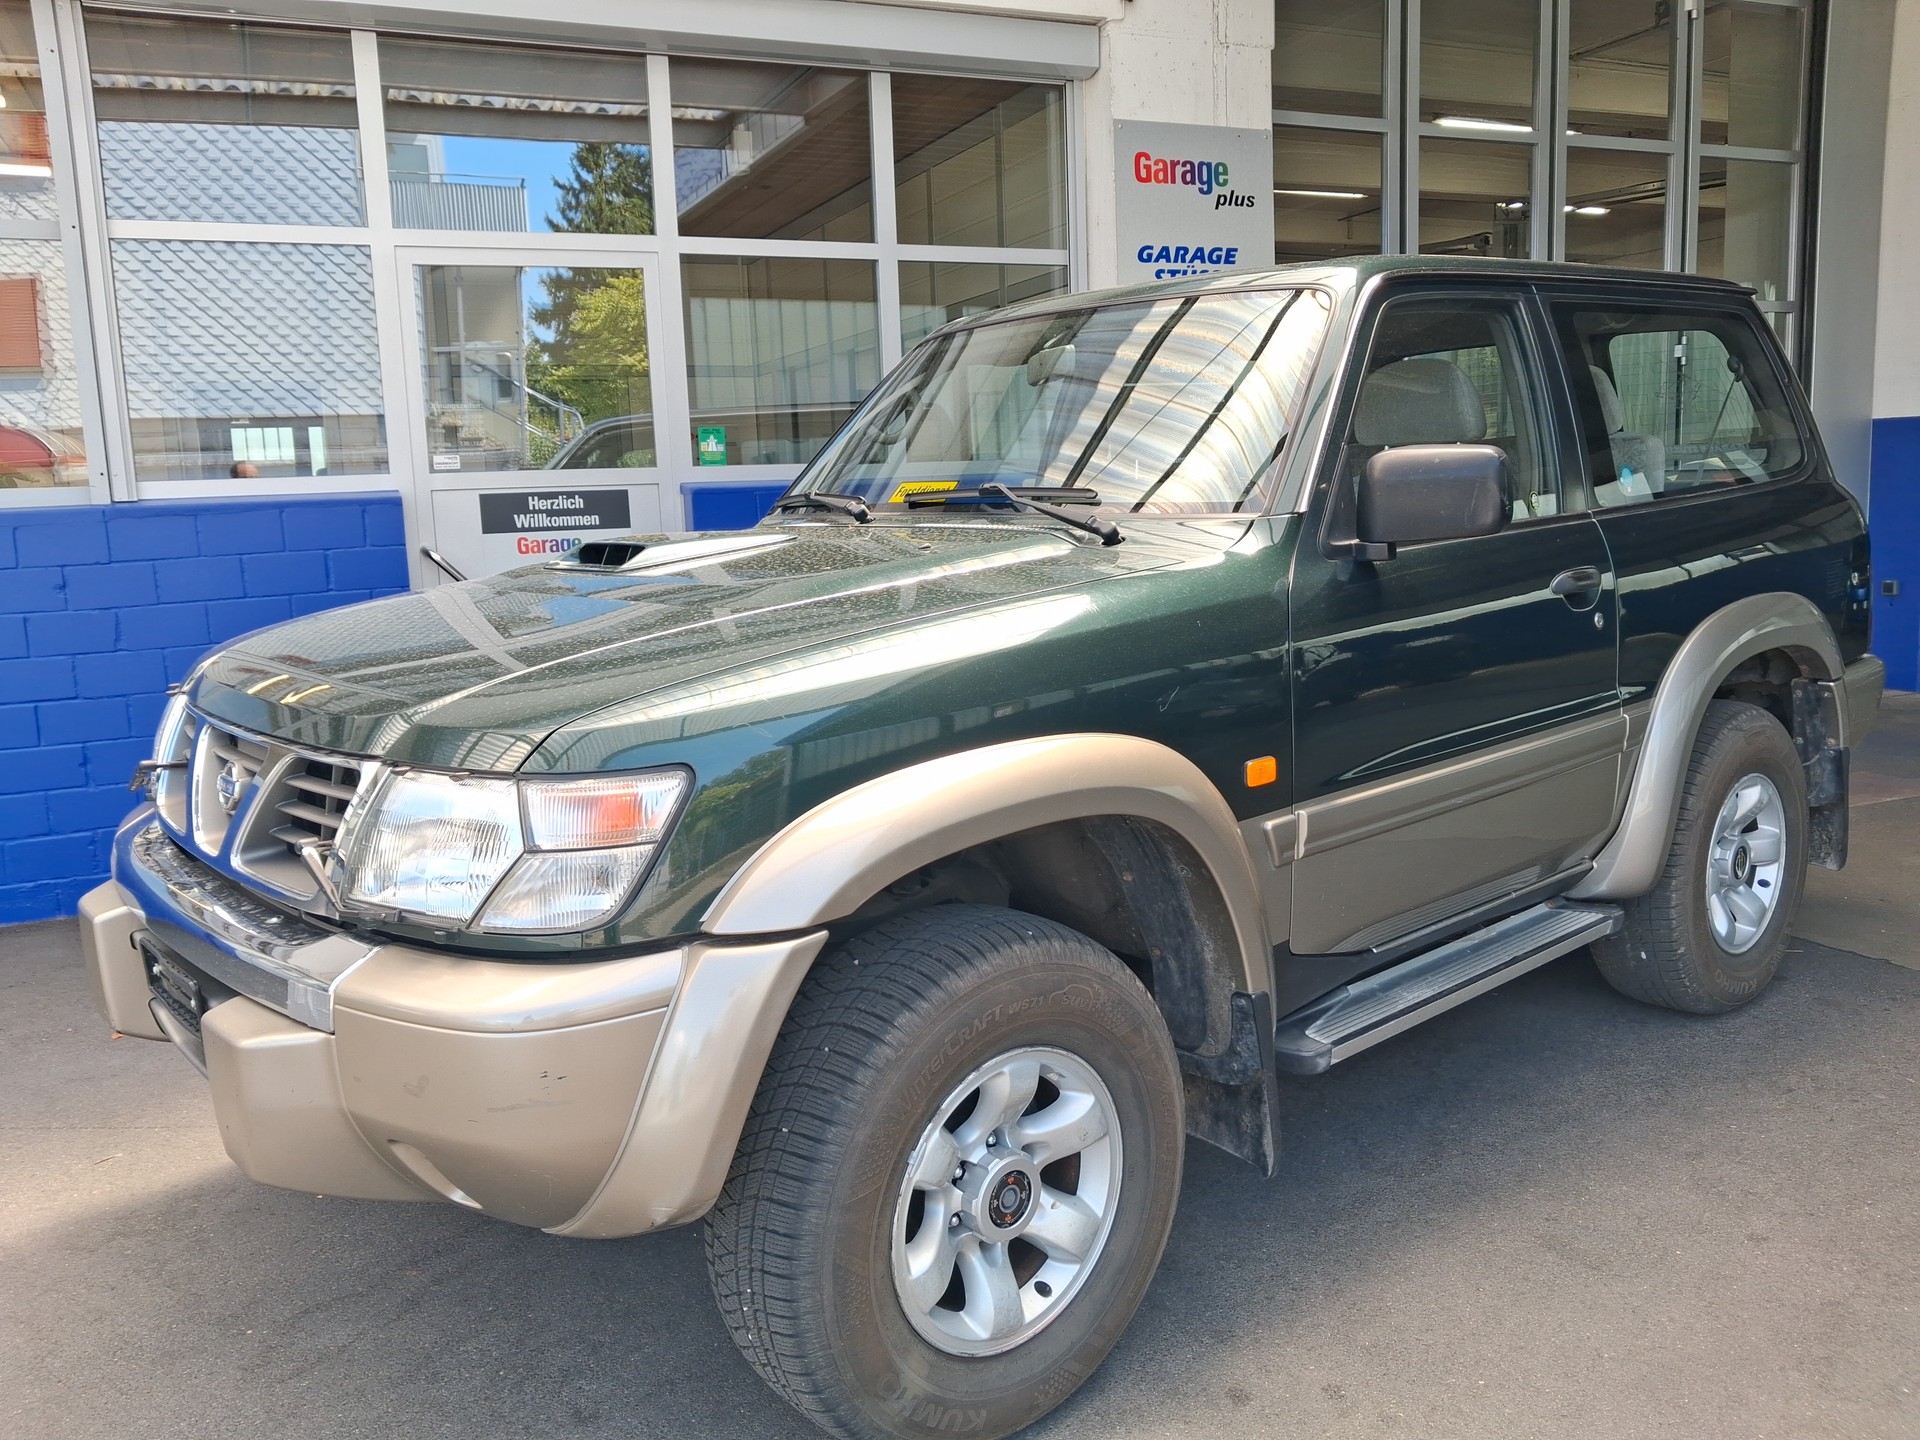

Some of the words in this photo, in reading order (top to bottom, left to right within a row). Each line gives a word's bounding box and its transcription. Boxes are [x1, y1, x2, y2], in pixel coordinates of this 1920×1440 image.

[1133, 151, 1229, 195] Garage
[1215, 190, 1256, 210] plus
[1137, 245, 1239, 265] GARAGE
[528, 495, 584, 510] Herzlich
[514, 513, 600, 528] Willkommen
[516, 536, 582, 555] Garage
